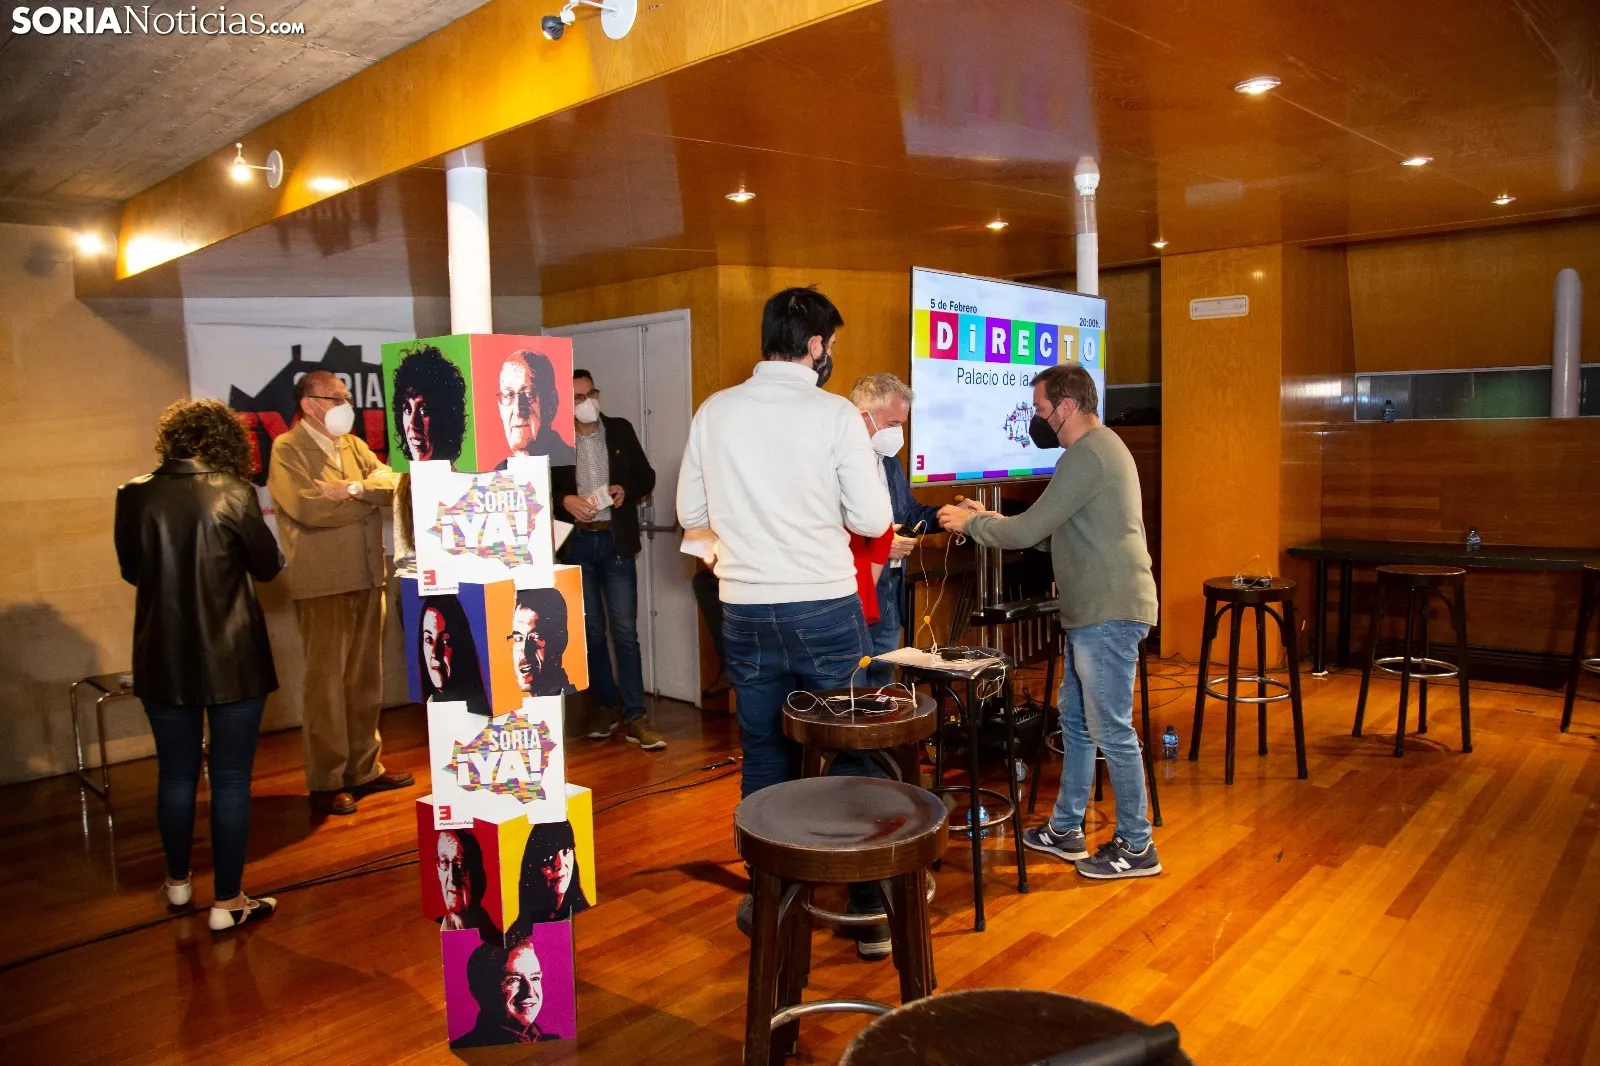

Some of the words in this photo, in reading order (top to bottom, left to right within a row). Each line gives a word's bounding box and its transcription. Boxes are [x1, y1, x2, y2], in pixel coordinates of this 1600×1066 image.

[930, 298, 936, 309] 5
[938, 300, 947, 310] de
[950, 300, 978, 314] Febrero
[1079, 317, 1101, 329] 20:00h.
[957, 367, 999, 386] Palacio
[1002, 369, 1016, 386] de
[1019, 370, 1029, 387] la
[473, 489, 528, 513] SORIA
[488, 728, 542, 752] SORIA
[1110, 857, 1132, 873] N
